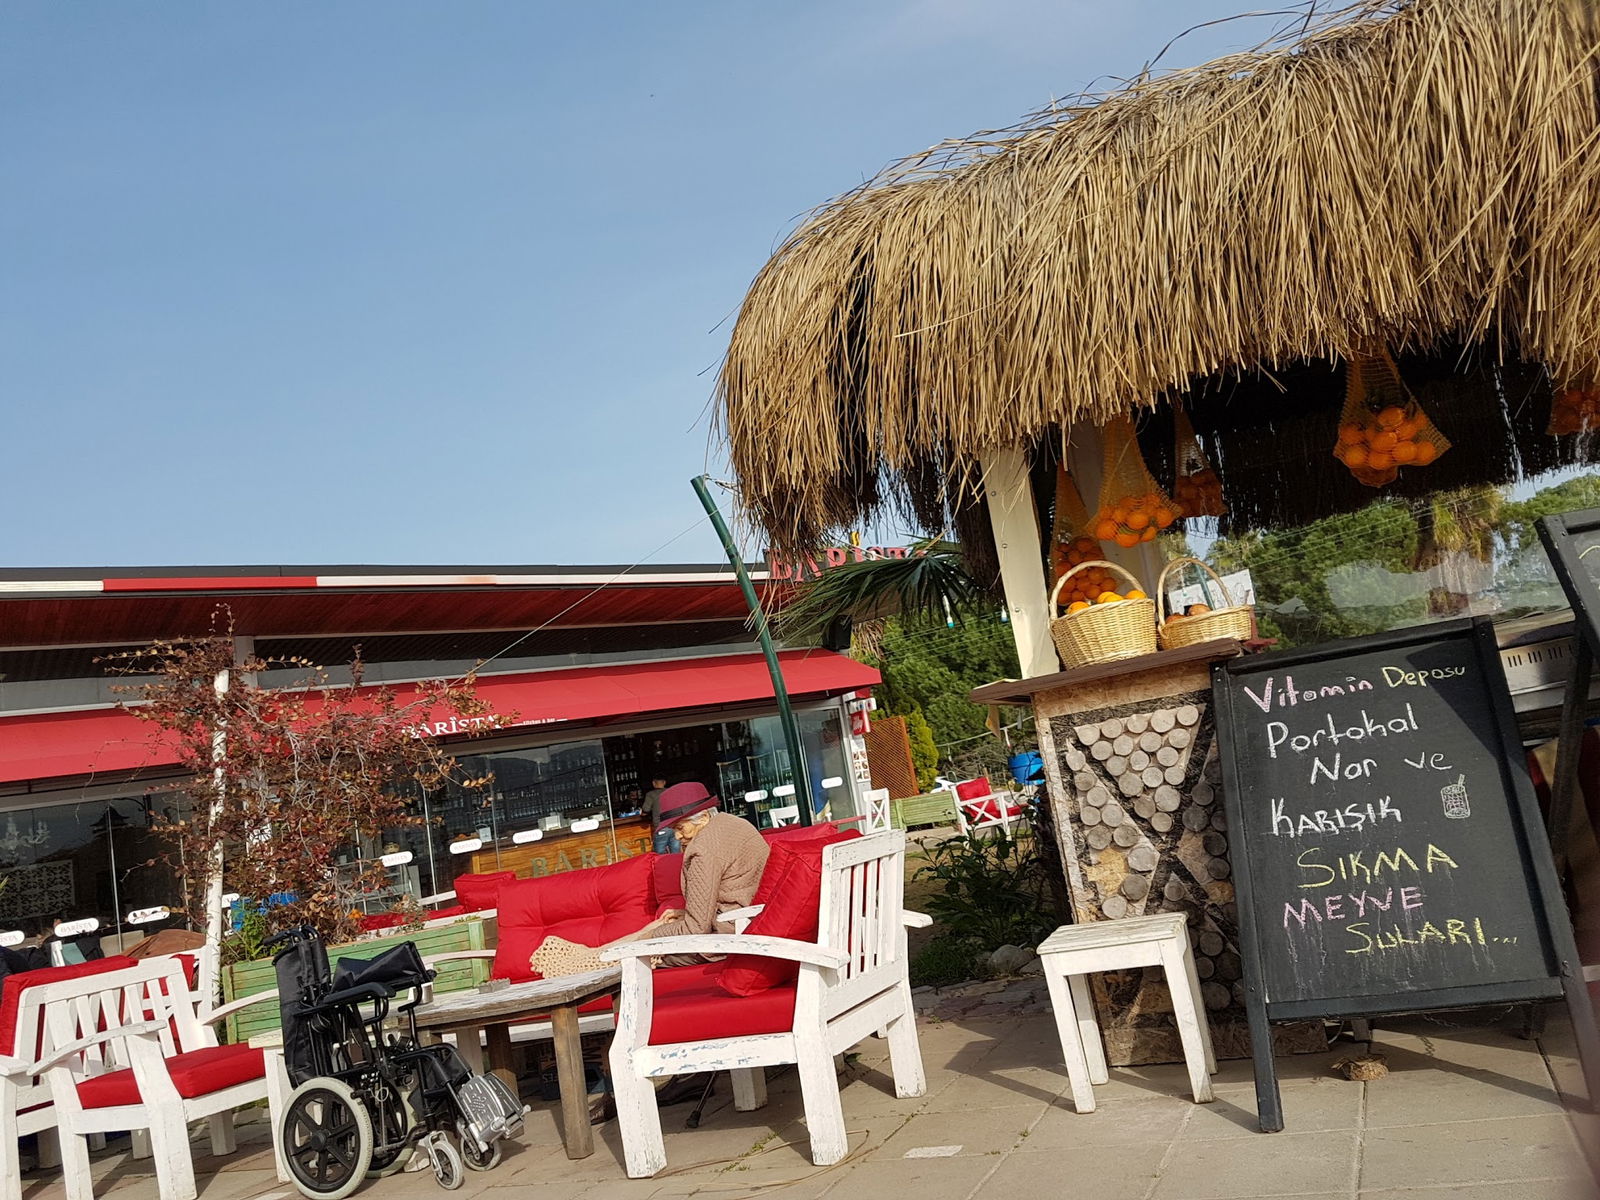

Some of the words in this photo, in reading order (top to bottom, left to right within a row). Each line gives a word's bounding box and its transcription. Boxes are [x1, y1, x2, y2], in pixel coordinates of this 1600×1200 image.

[1381, 665, 1466, 688] Deposu
[1404, 751, 1453, 770] ve
[1296, 843, 1460, 889] SIKMA
[1283, 886, 1424, 928] MEYVE
